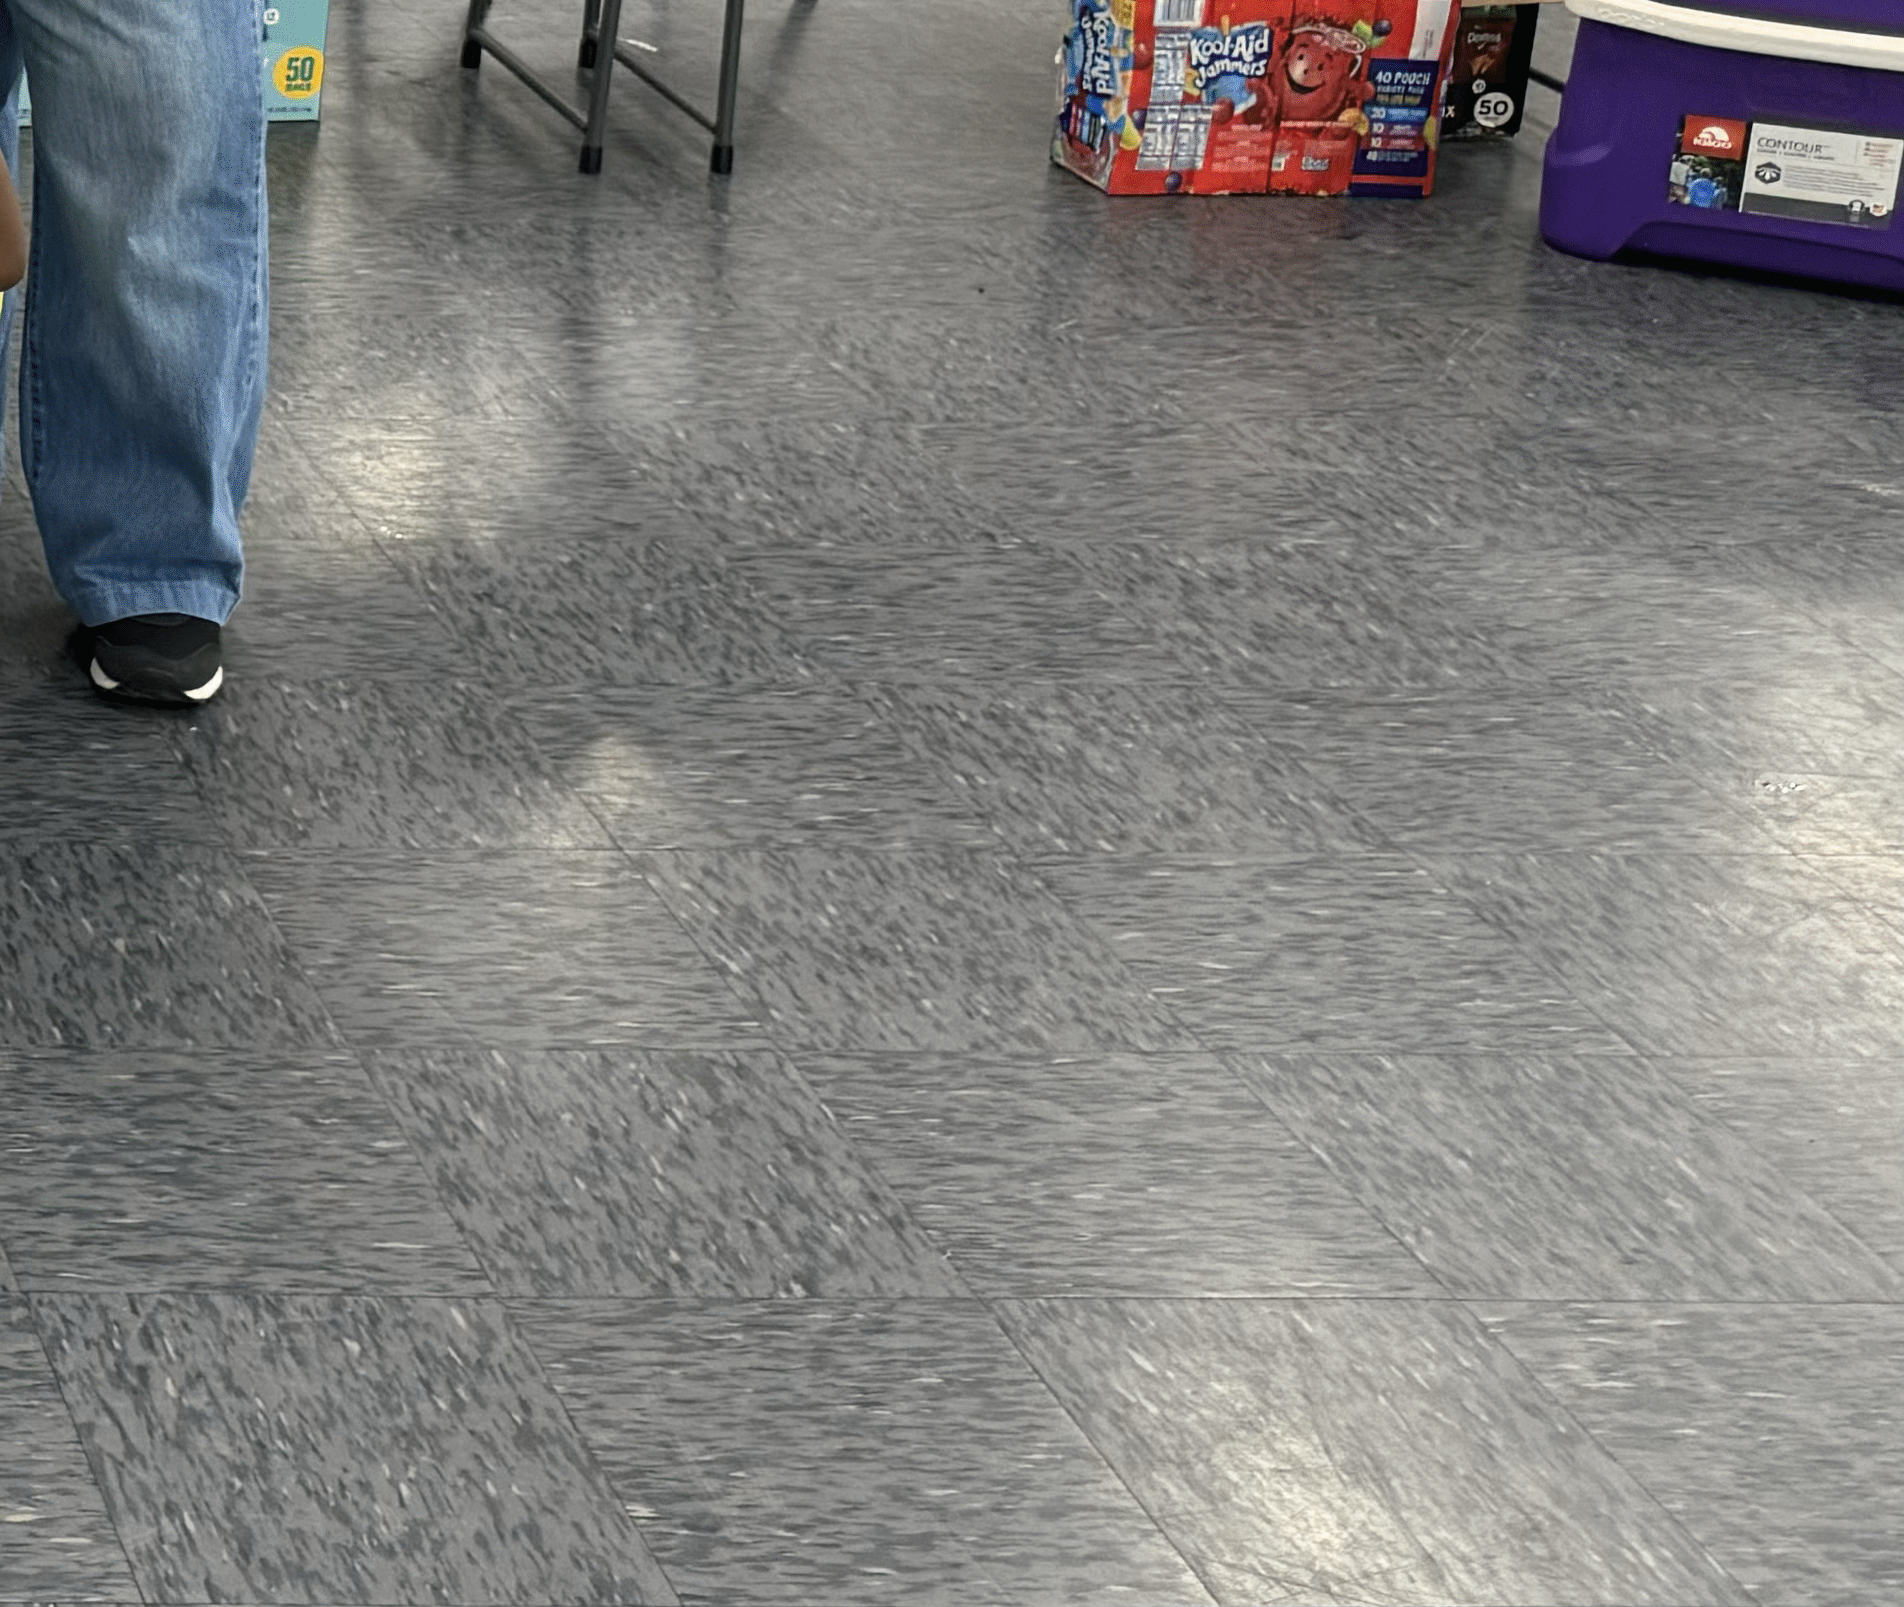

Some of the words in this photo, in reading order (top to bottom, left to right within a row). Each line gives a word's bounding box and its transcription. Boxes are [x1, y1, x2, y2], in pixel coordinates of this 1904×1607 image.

[1190, 28, 1270, 65] Kool-Aid
[285, 56, 316, 82] 50
[1195, 58, 1268, 88] Jammers
[1479, 99, 1509, 115] 50
[1757, 137, 1823, 154] CONTOUR
